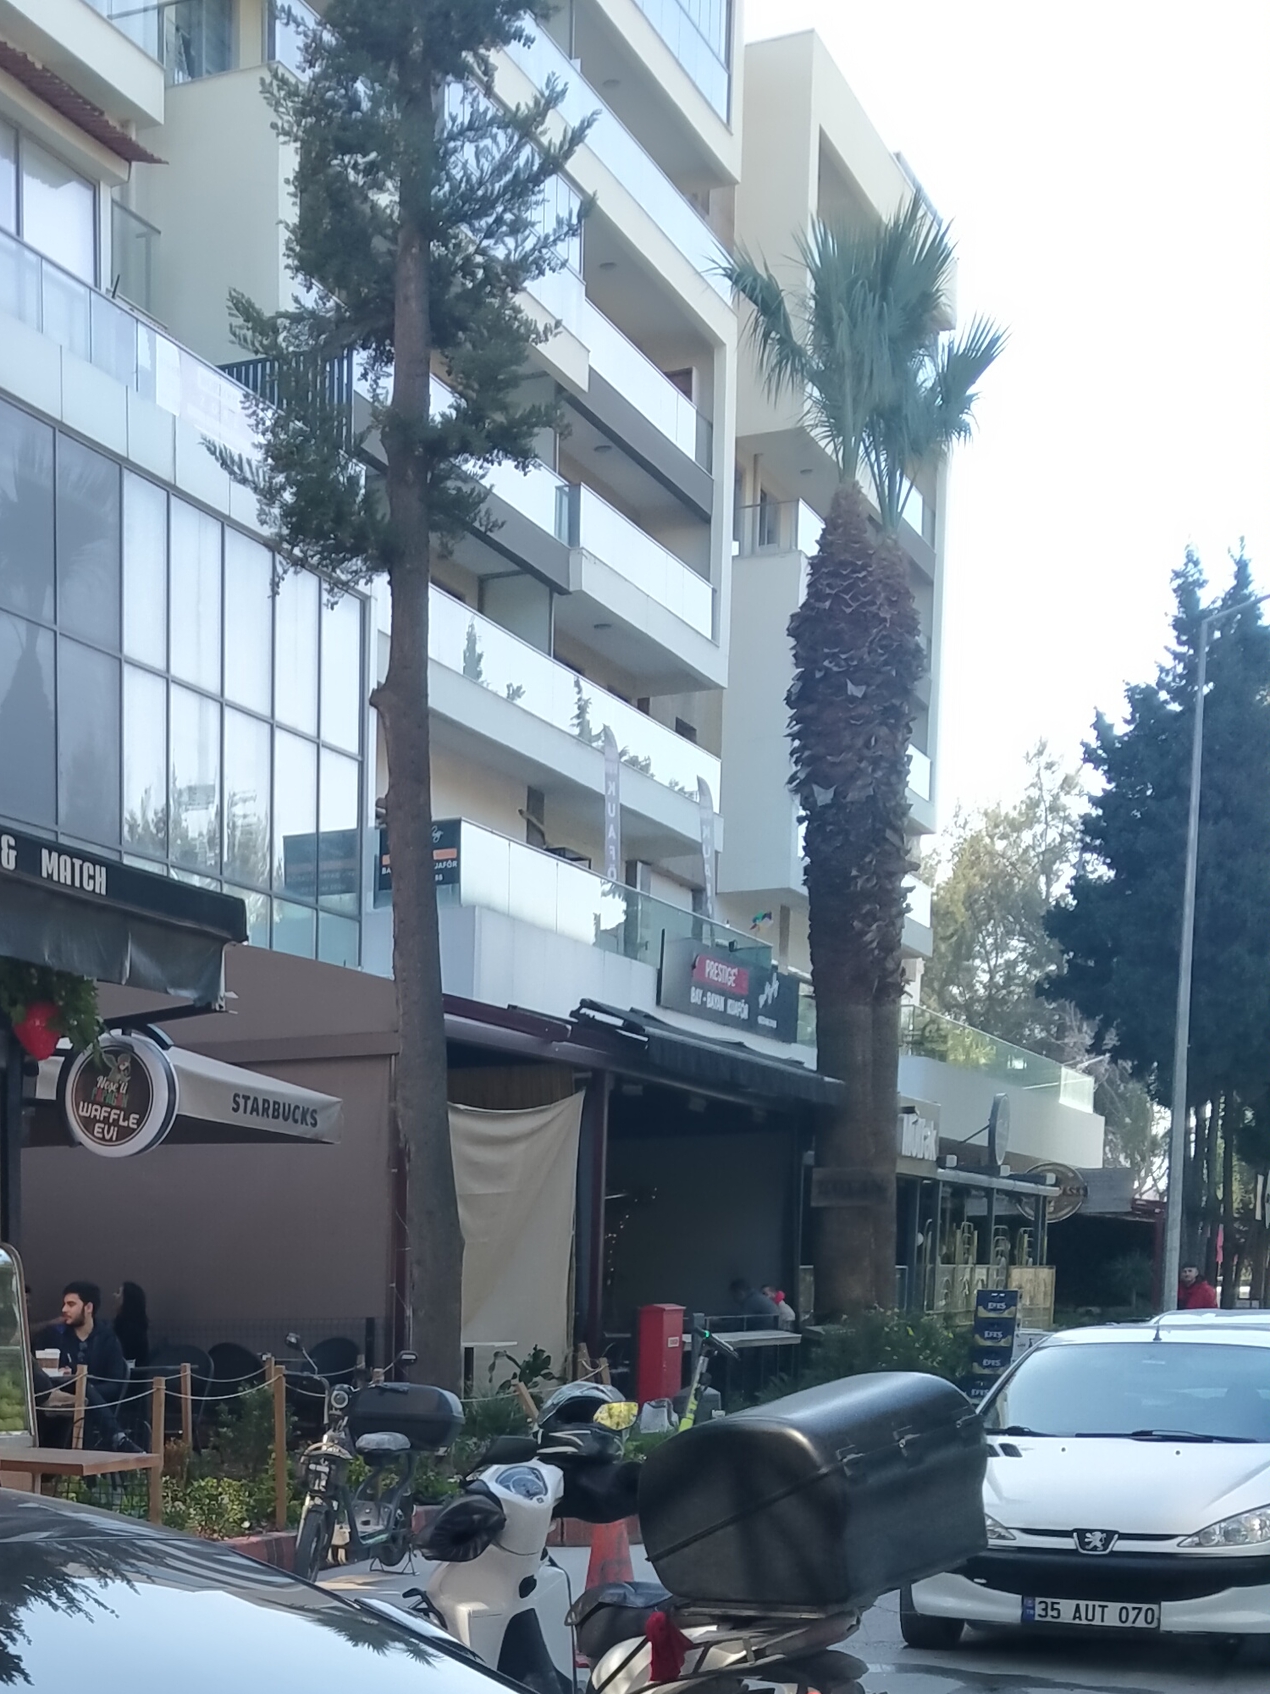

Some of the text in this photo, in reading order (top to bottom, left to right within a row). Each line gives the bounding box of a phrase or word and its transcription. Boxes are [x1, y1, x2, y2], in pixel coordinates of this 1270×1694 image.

[0, 834, 17, 871] &
[41, 847, 107, 896] MATCH
[78, 1100, 140, 1129] WAFFLE
[231, 1092, 319, 1129] STARBUCKS
[1037, 1601, 1155, 1626] 35 AUT 070
